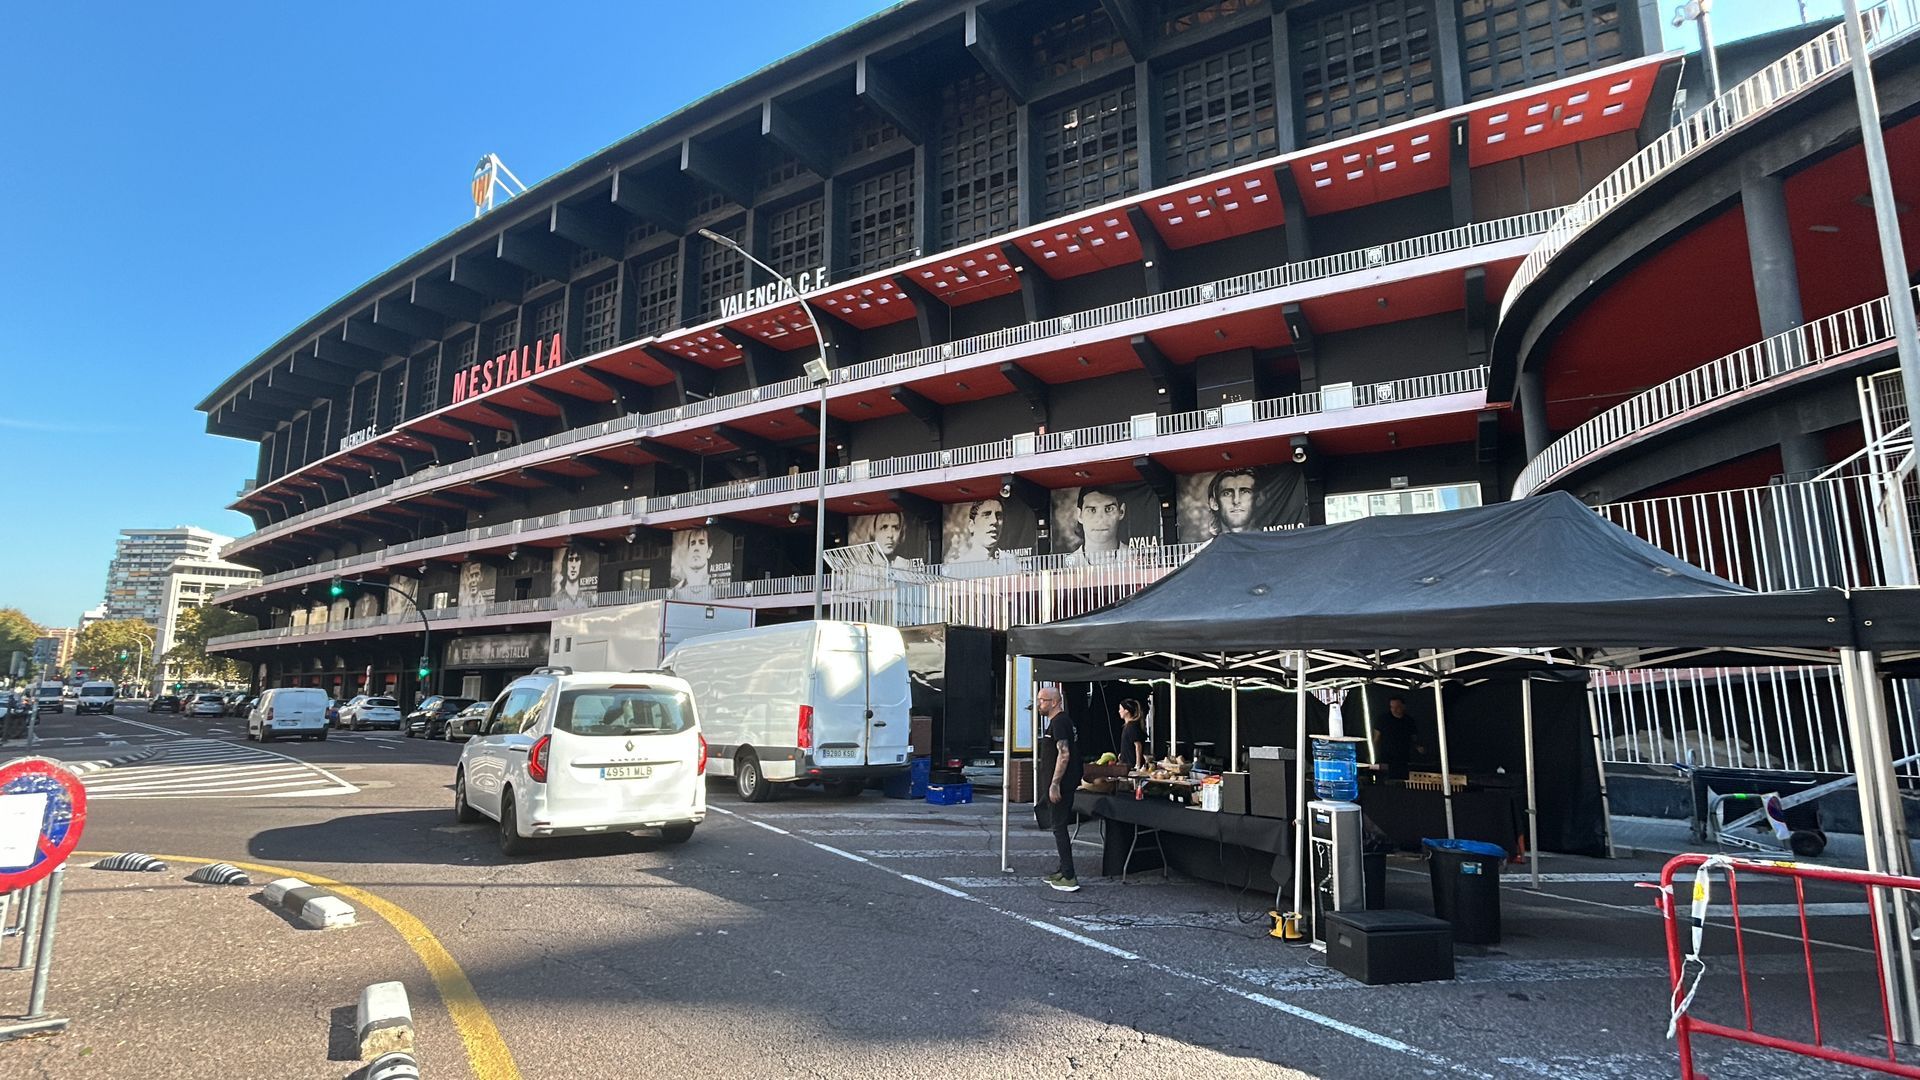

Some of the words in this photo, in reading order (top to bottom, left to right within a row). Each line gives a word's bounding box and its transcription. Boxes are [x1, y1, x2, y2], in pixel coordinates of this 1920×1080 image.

[720, 278, 794, 318] VALENCIA
[800, 266, 830, 295] C.F.
[452, 333, 561, 404] MESTALLA
[1129, 535, 1158, 549] AYALA
[710, 562, 731, 572] ALBELDA
[580, 576, 599, 585] KEMPES
[606, 767, 630, 777] 4951
